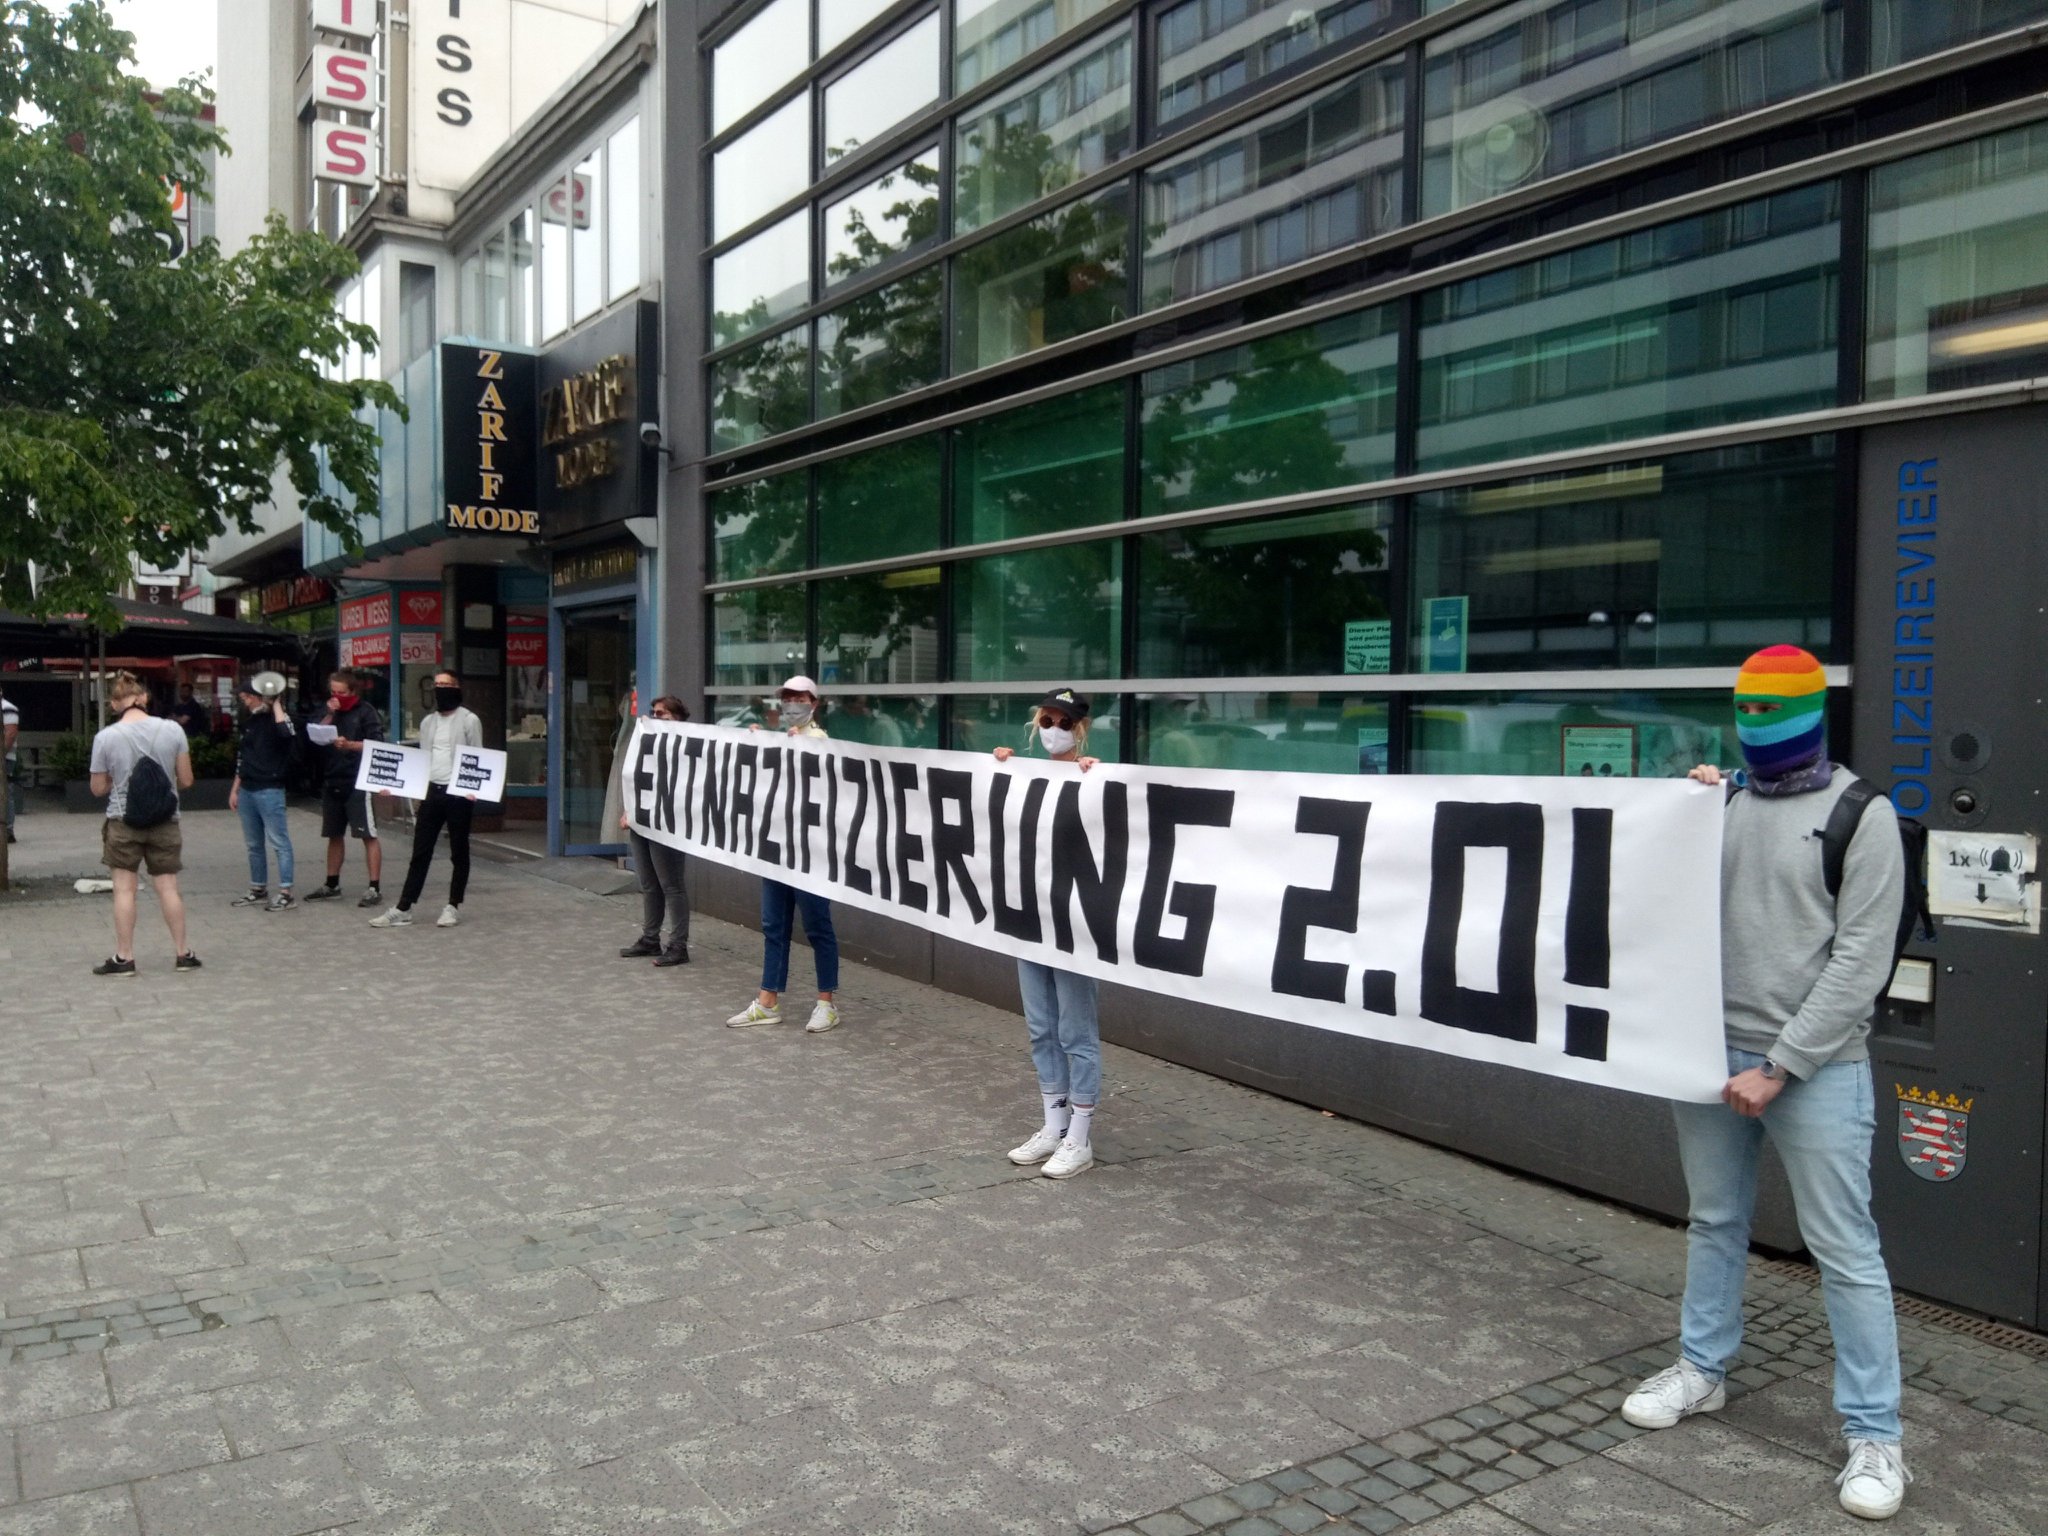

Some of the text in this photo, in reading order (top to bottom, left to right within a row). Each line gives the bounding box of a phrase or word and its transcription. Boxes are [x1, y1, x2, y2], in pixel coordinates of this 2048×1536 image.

[477, 349, 508, 501] ZARIF
[447, 503, 541, 535] MODE
[402, 644, 437, 661] 50%
[1891, 456, 1939, 818] OLIZEIREVIER
[461, 755, 478, 766] Kein
[1948, 850, 1971, 867] 1x
[634, 732, 1614, 1062] ENTNAZIFIZIERUNG 2.0!
